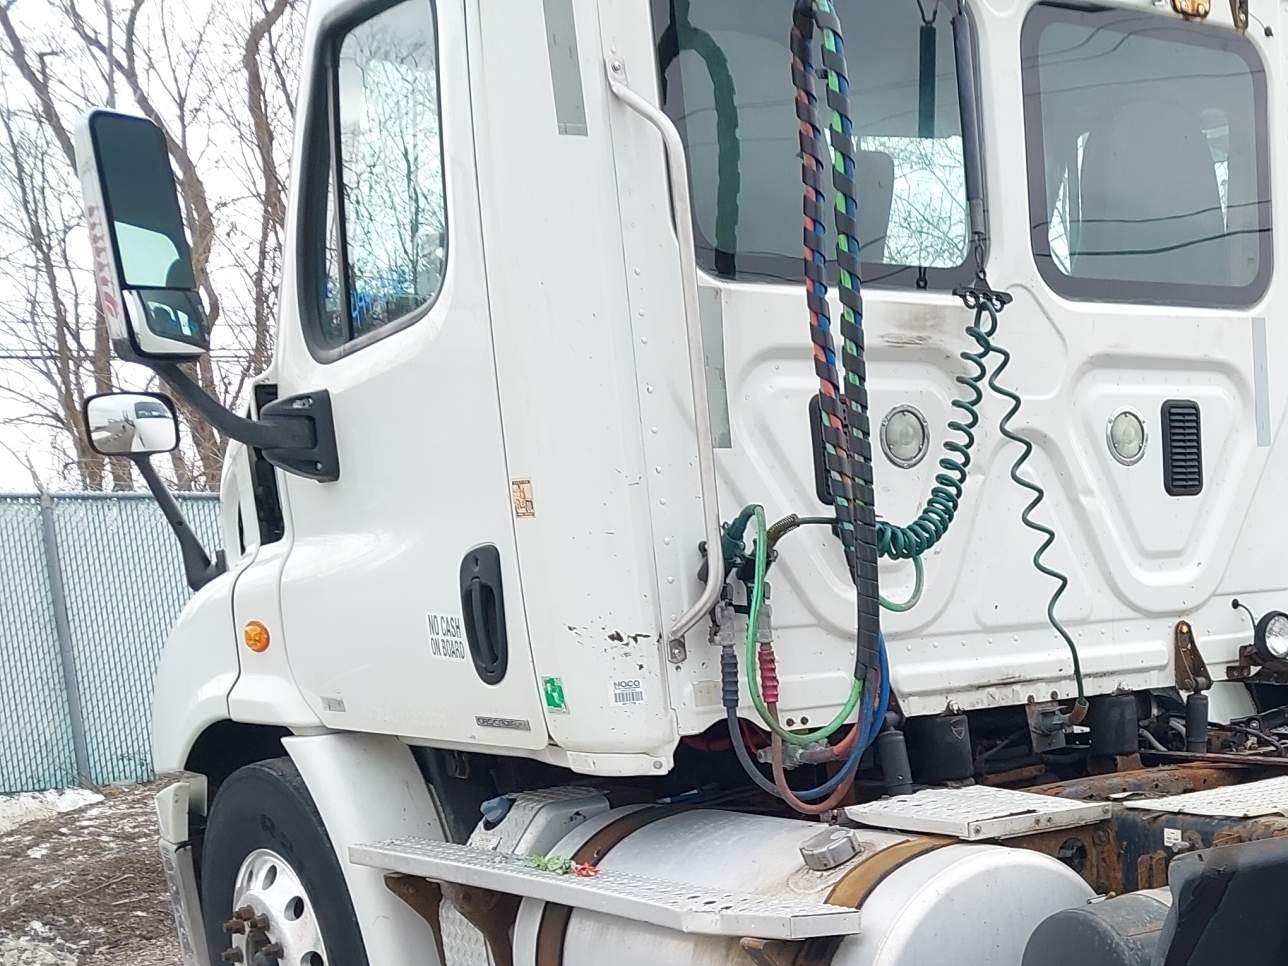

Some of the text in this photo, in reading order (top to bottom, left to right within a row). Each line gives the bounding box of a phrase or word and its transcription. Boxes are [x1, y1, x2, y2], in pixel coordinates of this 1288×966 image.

[427, 614, 461, 638] NO CASH
[430, 637, 465, 659] ON BOARD
[613, 679, 641, 688] NOCO
